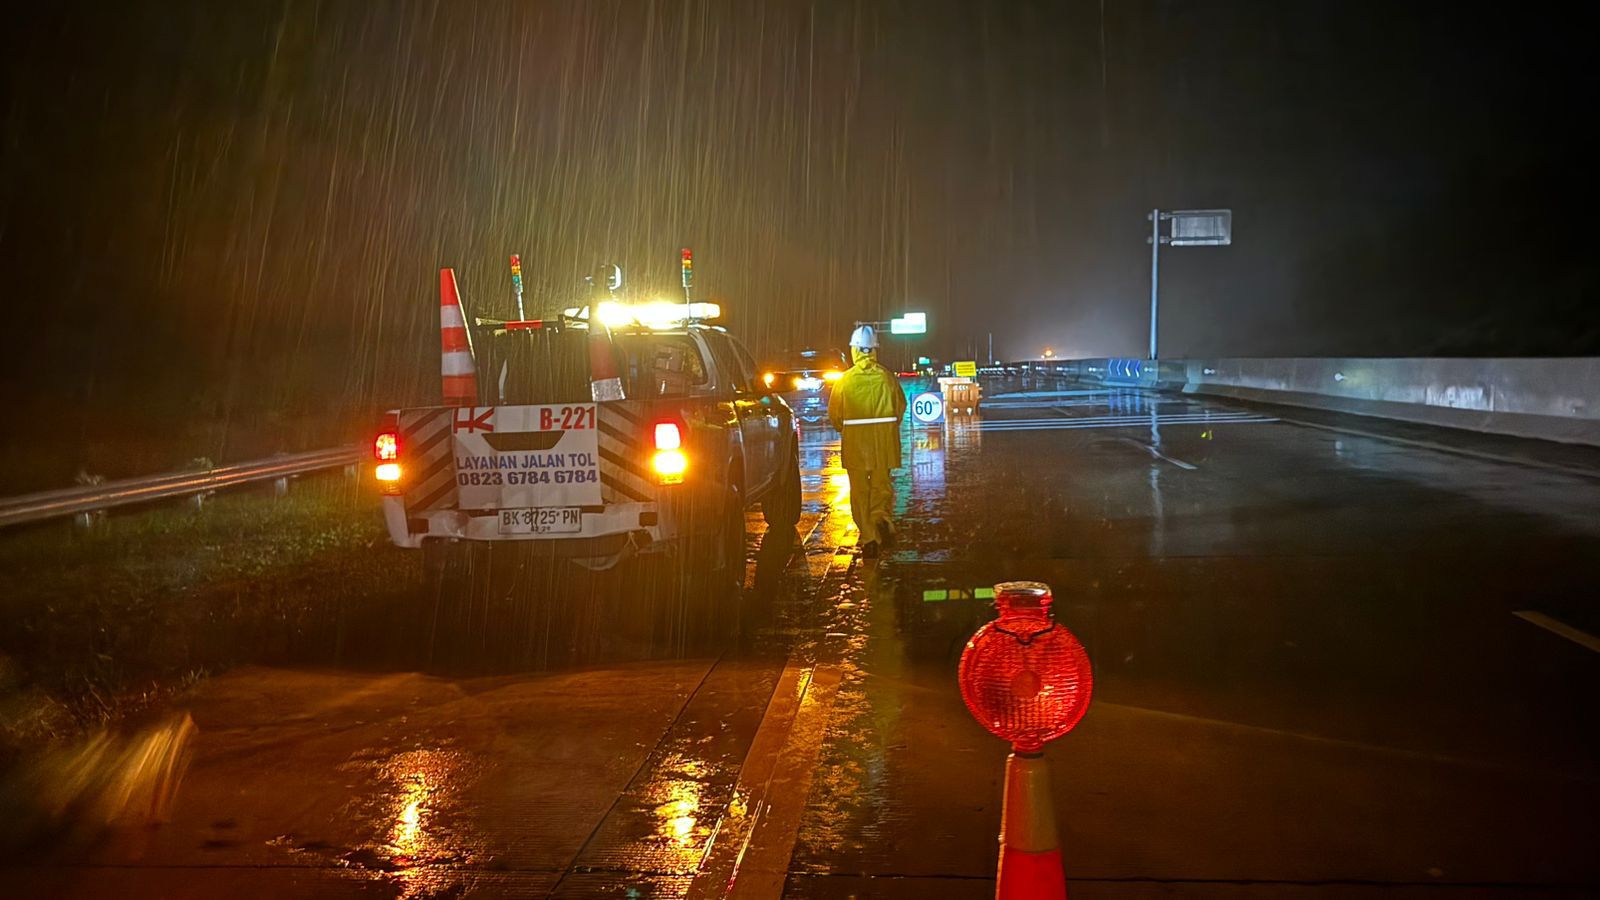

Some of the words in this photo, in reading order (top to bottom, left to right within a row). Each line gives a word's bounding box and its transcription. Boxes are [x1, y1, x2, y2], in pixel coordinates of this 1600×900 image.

[915, 400, 932, 415] 60
[540, 406, 596, 430] B-221
[456, 456, 517, 470] LAYANAN
[521, 454, 565, 468] JALAN
[569, 453, 596, 466] TOL
[458, 472, 503, 486] 0823
[507, 471, 551, 485] 6784
[554, 470, 597, 484] 6784
[503, 511, 519, 526] BK
[562, 509, 578, 524] PN
